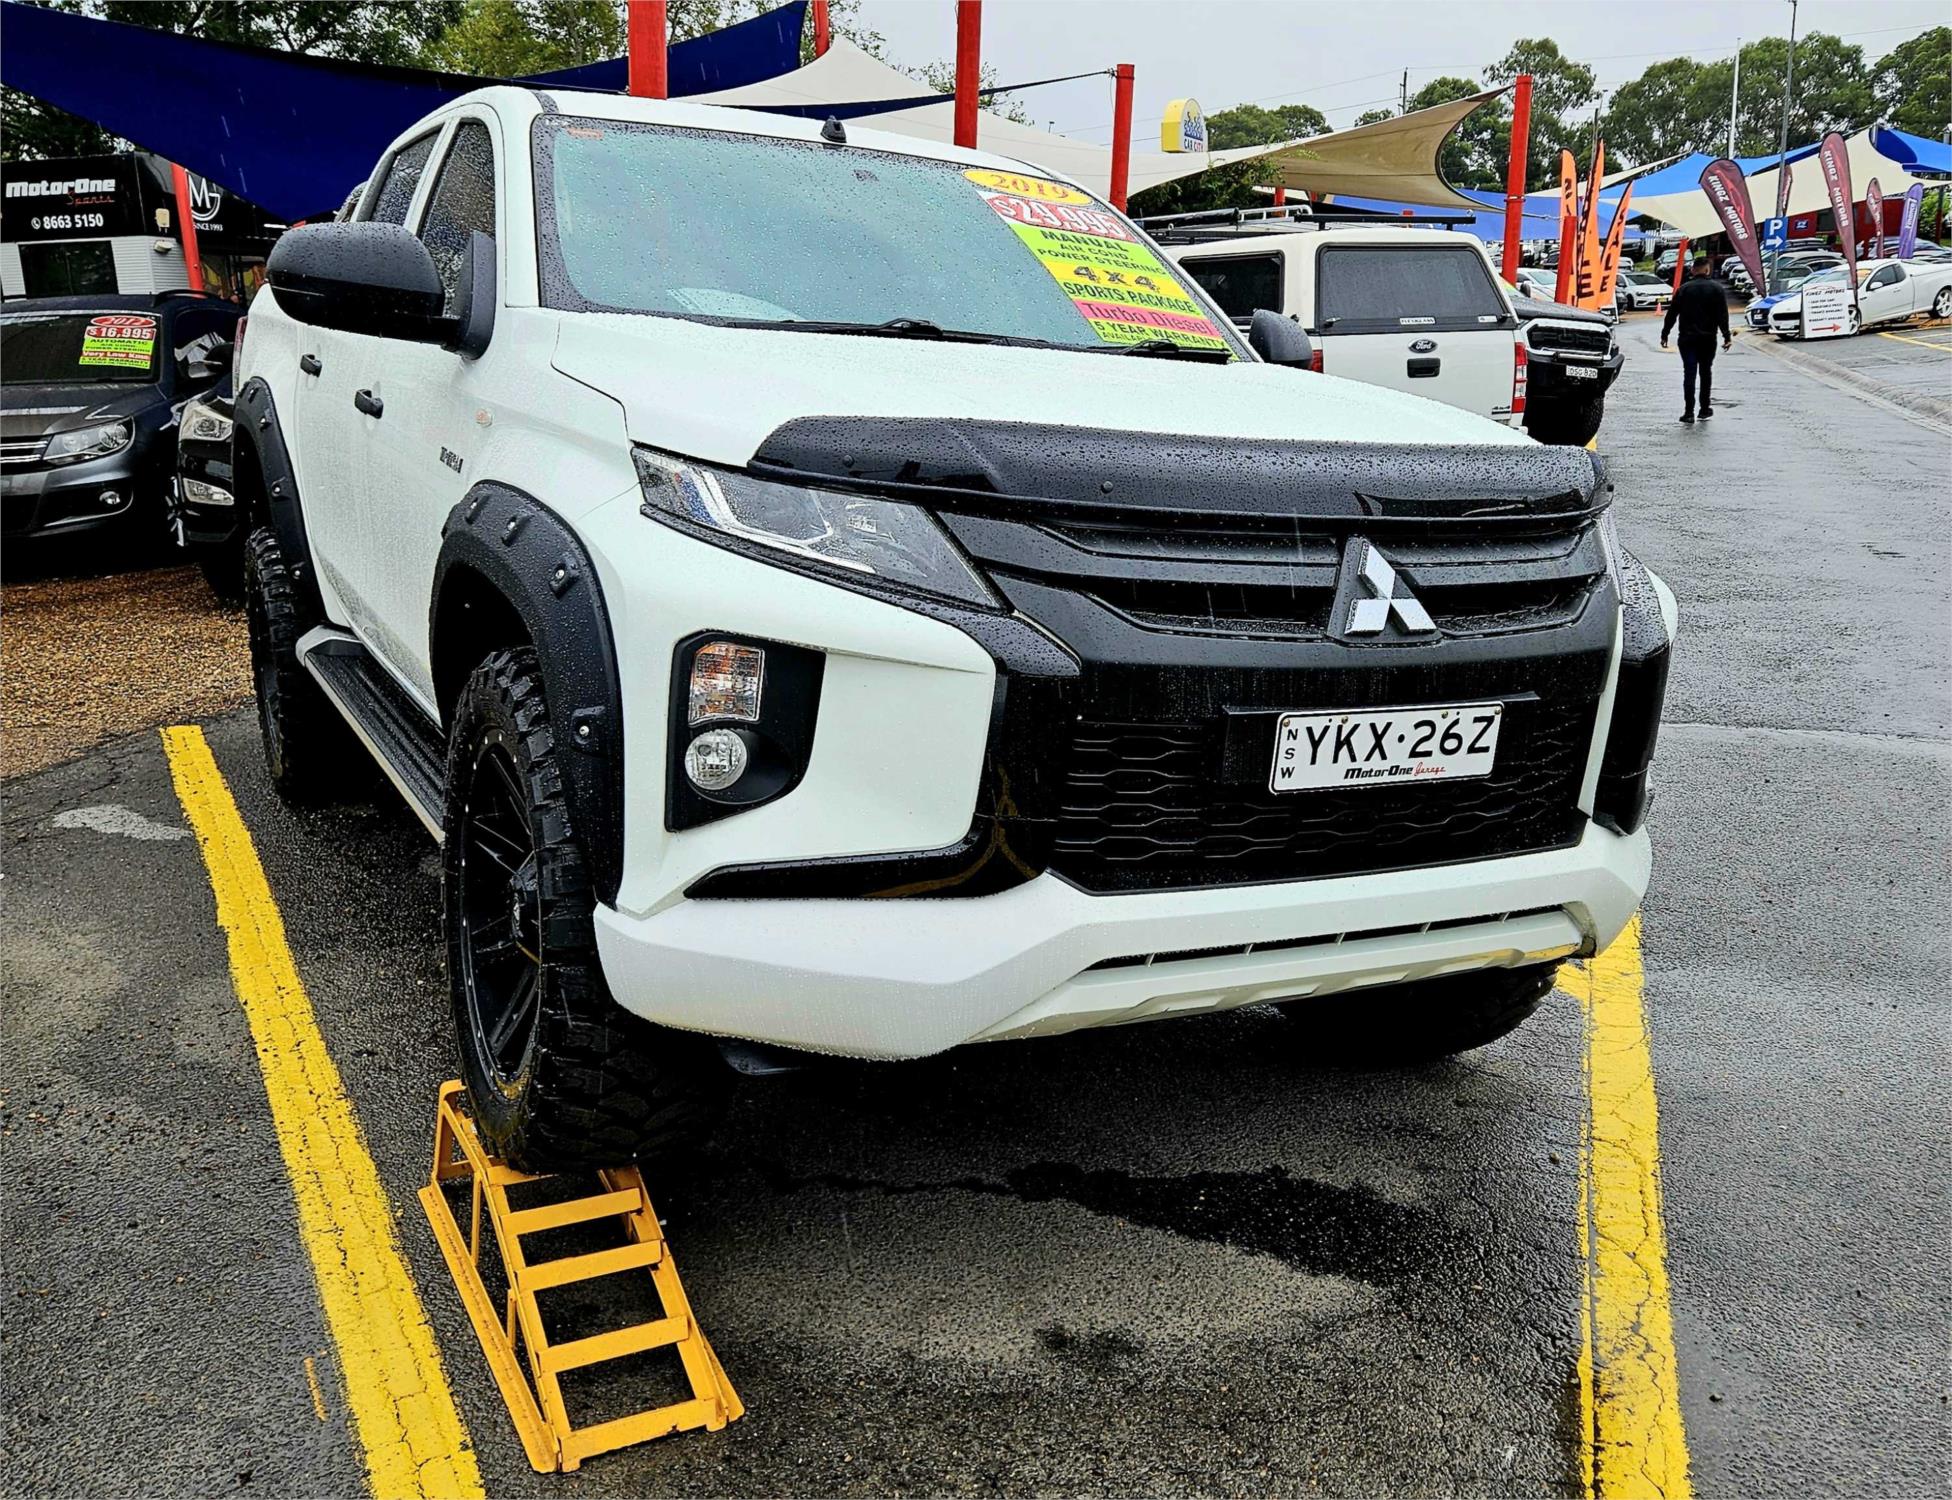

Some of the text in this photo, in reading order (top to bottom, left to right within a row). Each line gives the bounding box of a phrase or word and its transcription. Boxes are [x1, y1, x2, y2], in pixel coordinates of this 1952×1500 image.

[6, 178, 116, 198] MotorOne
[990, 174, 1069, 198] 2019
[1824, 150, 1849, 227] KINGZ MOTORS
[994, 198, 1127, 240] $29,995
[1708, 175, 1749, 240] KINGZ MOTORS
[43, 212, 104, 230] 8663 5150
[210, 223, 223, 232] 1993
[1770, 220, 1783, 236] P
[1040, 230, 1128, 252] MANUAL
[1060, 243, 1134, 261] AIR COND.
[1600, 206, 1626, 293] SALE
[1037, 248, 1167, 275] POWER STEERING
[1073, 266, 1101, 284] 4
[1135, 276, 1161, 294] 4
[1063, 282, 1197, 313] SPORTS PACKAGE
[1082, 302, 1214, 336] Turbo Diesel
[1094, 321, 1226, 349] 5 YEAR WARRANTY
[1415, 340, 1432, 350] Ford
[82, 350, 105, 358] Very
[1344, 761, 1447, 779] MotorOne Garage
